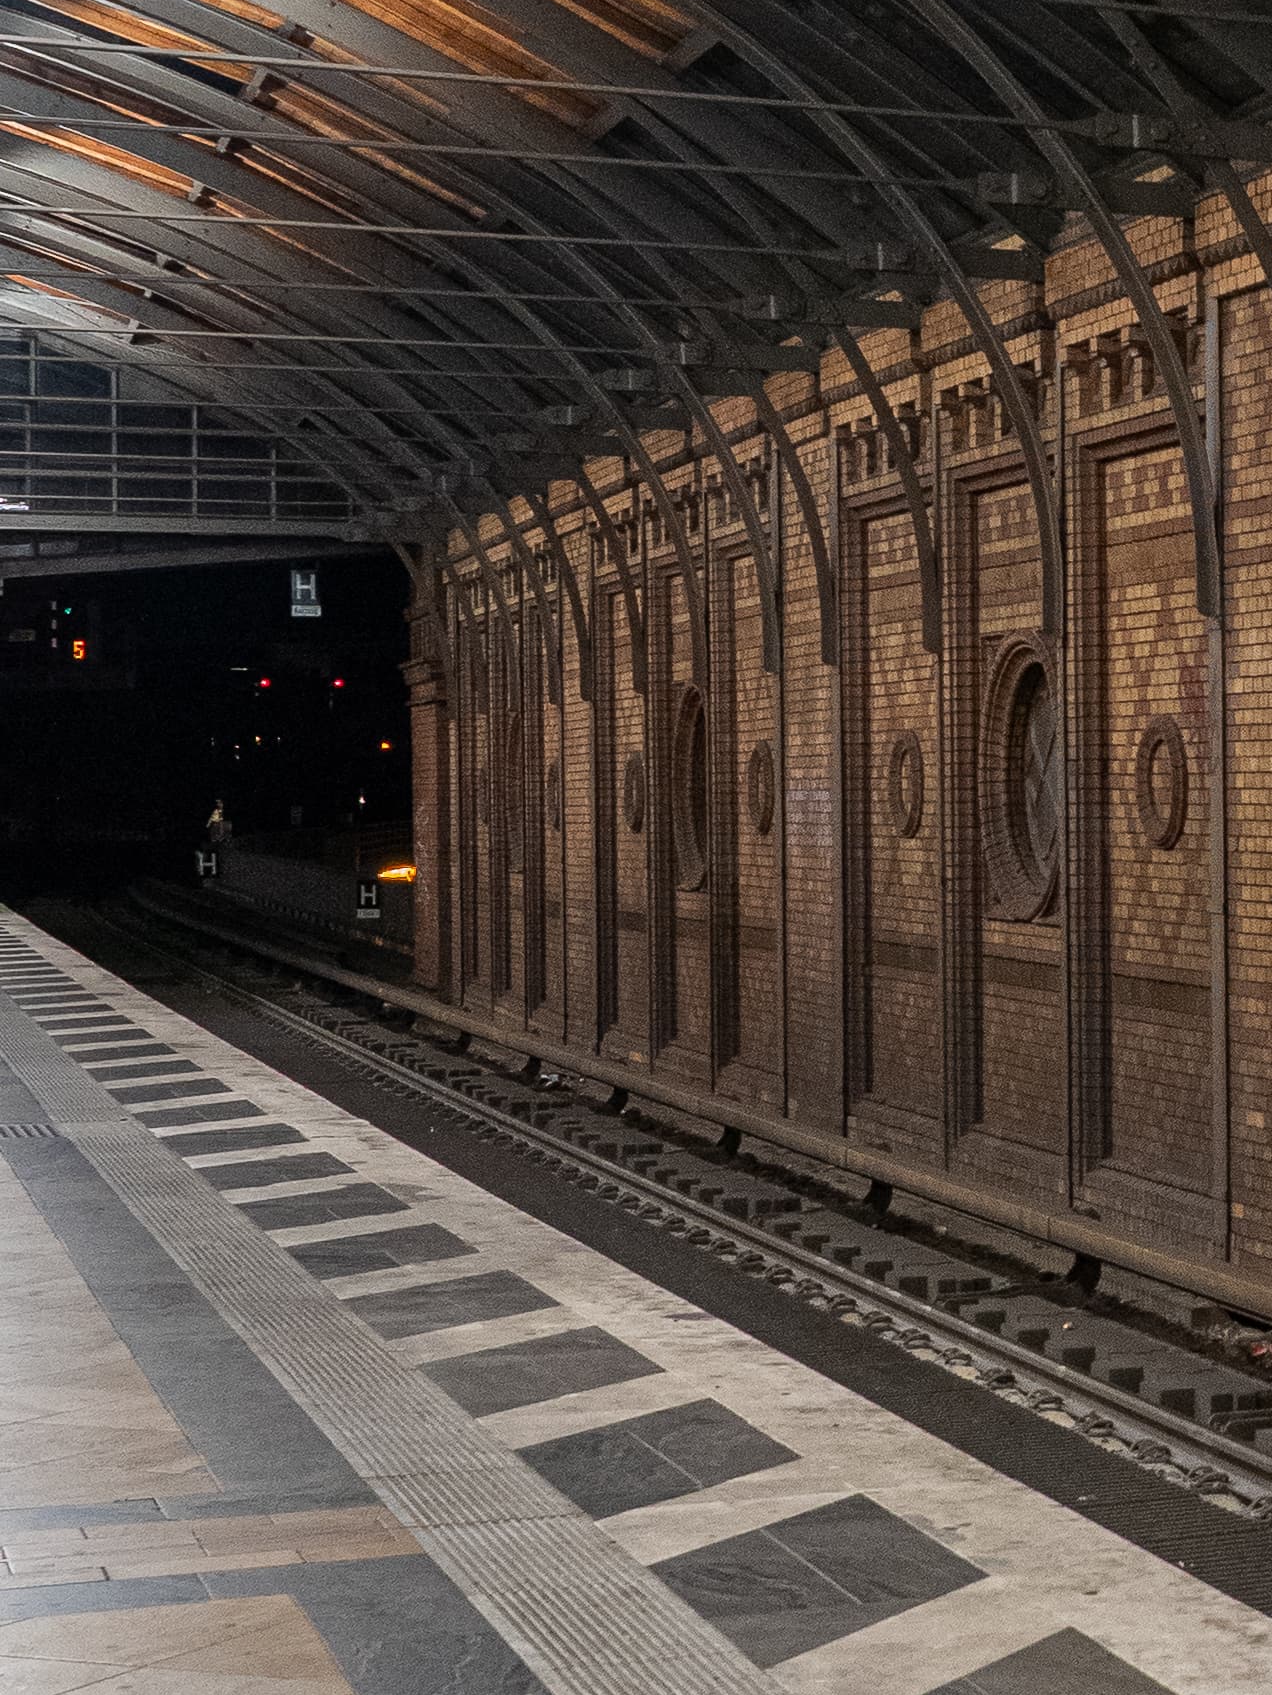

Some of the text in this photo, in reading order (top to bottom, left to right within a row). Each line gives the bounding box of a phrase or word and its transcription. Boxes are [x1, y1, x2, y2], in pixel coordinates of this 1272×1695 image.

[296, 574, 316, 600] H
[73, 640, 85, 660] 5
[199, 851, 216, 876] H
[360, 884, 377, 905] H
